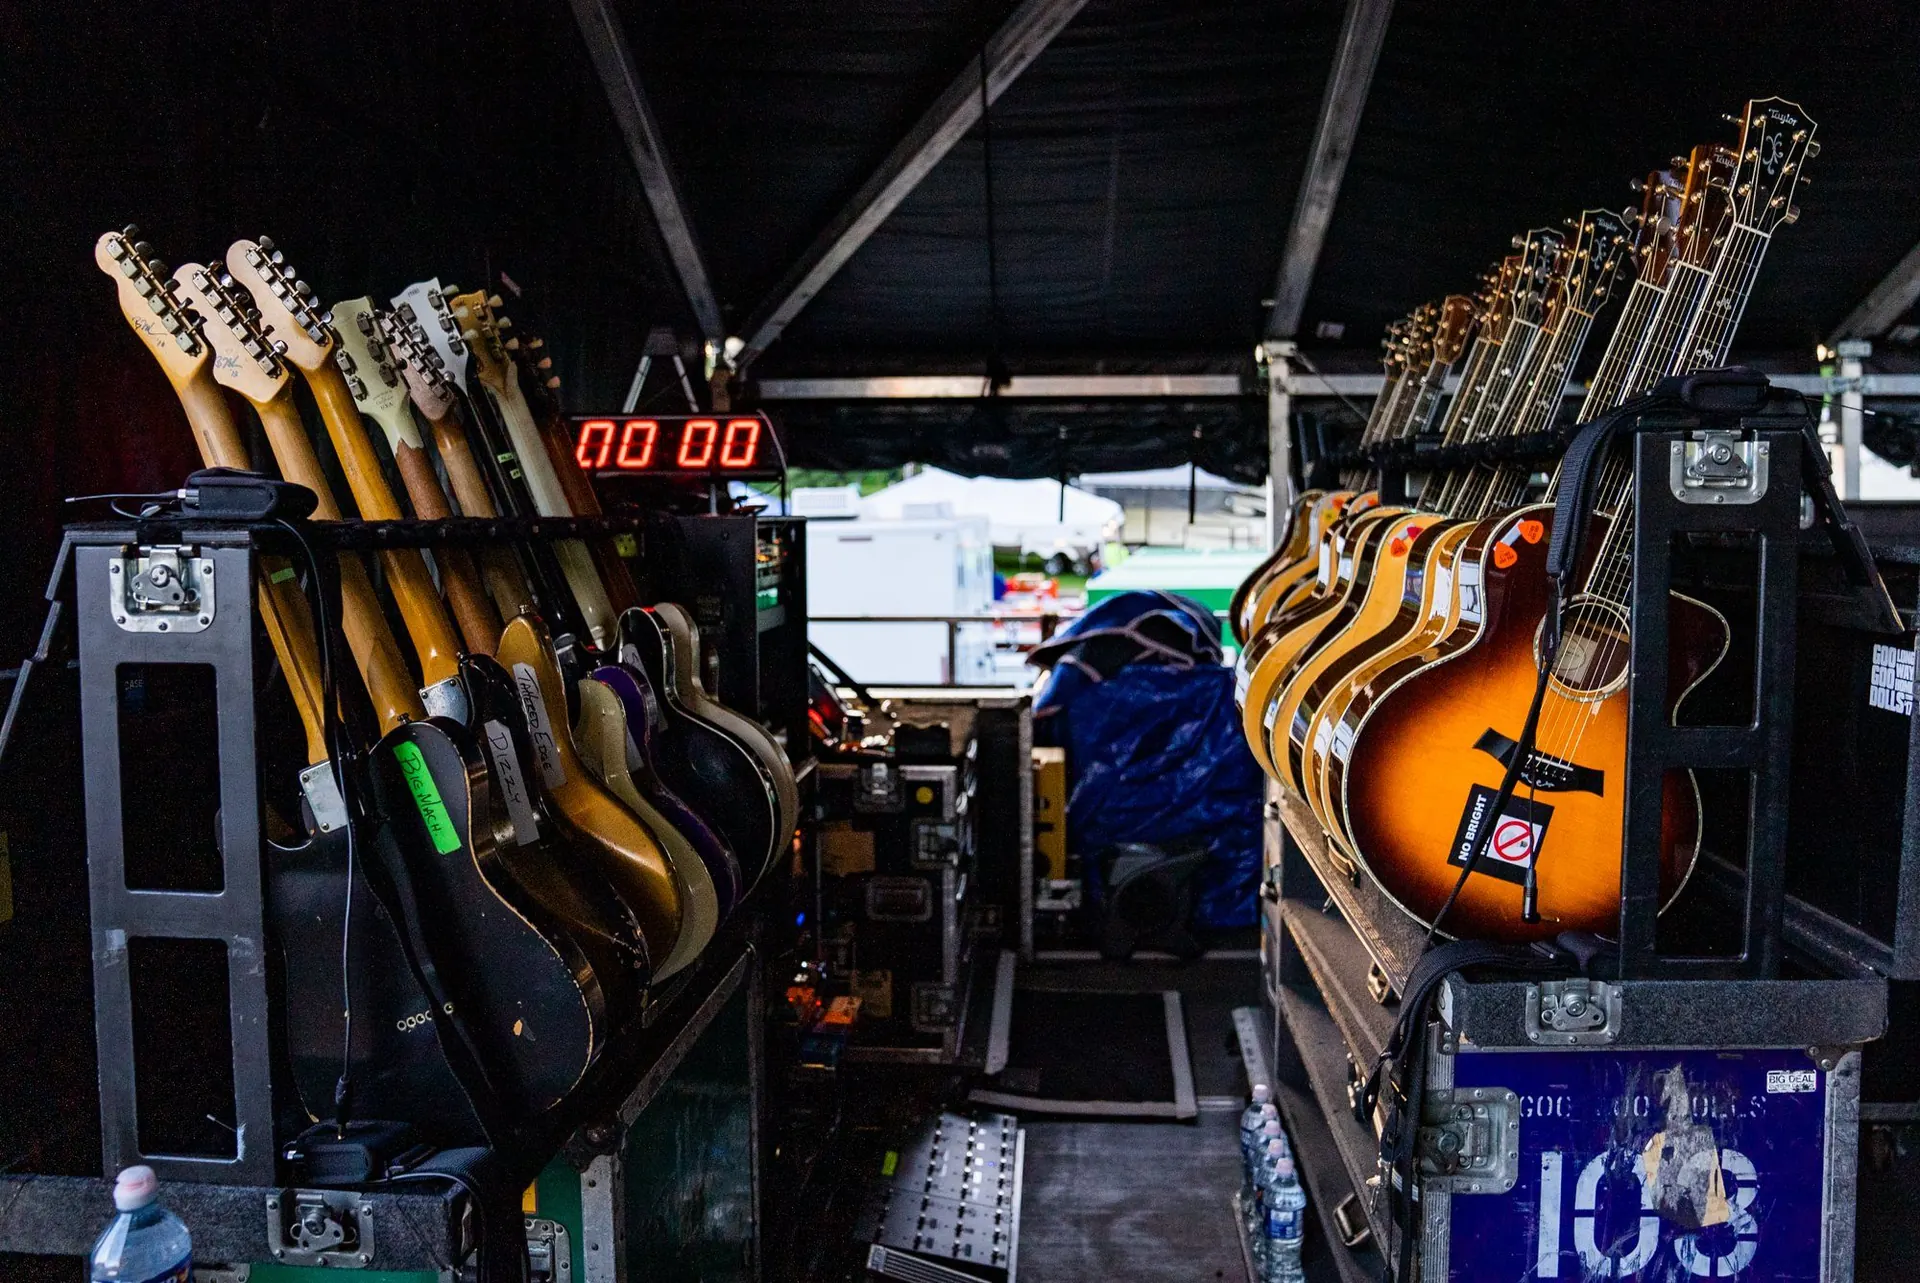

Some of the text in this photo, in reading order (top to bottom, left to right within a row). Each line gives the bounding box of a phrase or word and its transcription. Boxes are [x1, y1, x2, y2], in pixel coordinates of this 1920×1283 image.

[1768, 108, 1798, 126] Taylor
[1714, 154, 1735, 168] Tayl
[1873, 644, 1897, 668] GOO
[1871, 663, 1915, 690] GOO WAY
[1869, 684, 1905, 714] DOLLS
[534, 732, 554, 771] EDGE
[400, 751, 424, 790] BIG
[488, 732, 522, 804] DIZZY
[1464, 793, 1488, 842] BRIGHT
[1458, 842, 1472, 861] NO
[1768, 1074, 1815, 1084] BIG DEAL
[1692, 1095, 1767, 1118] OLLS
